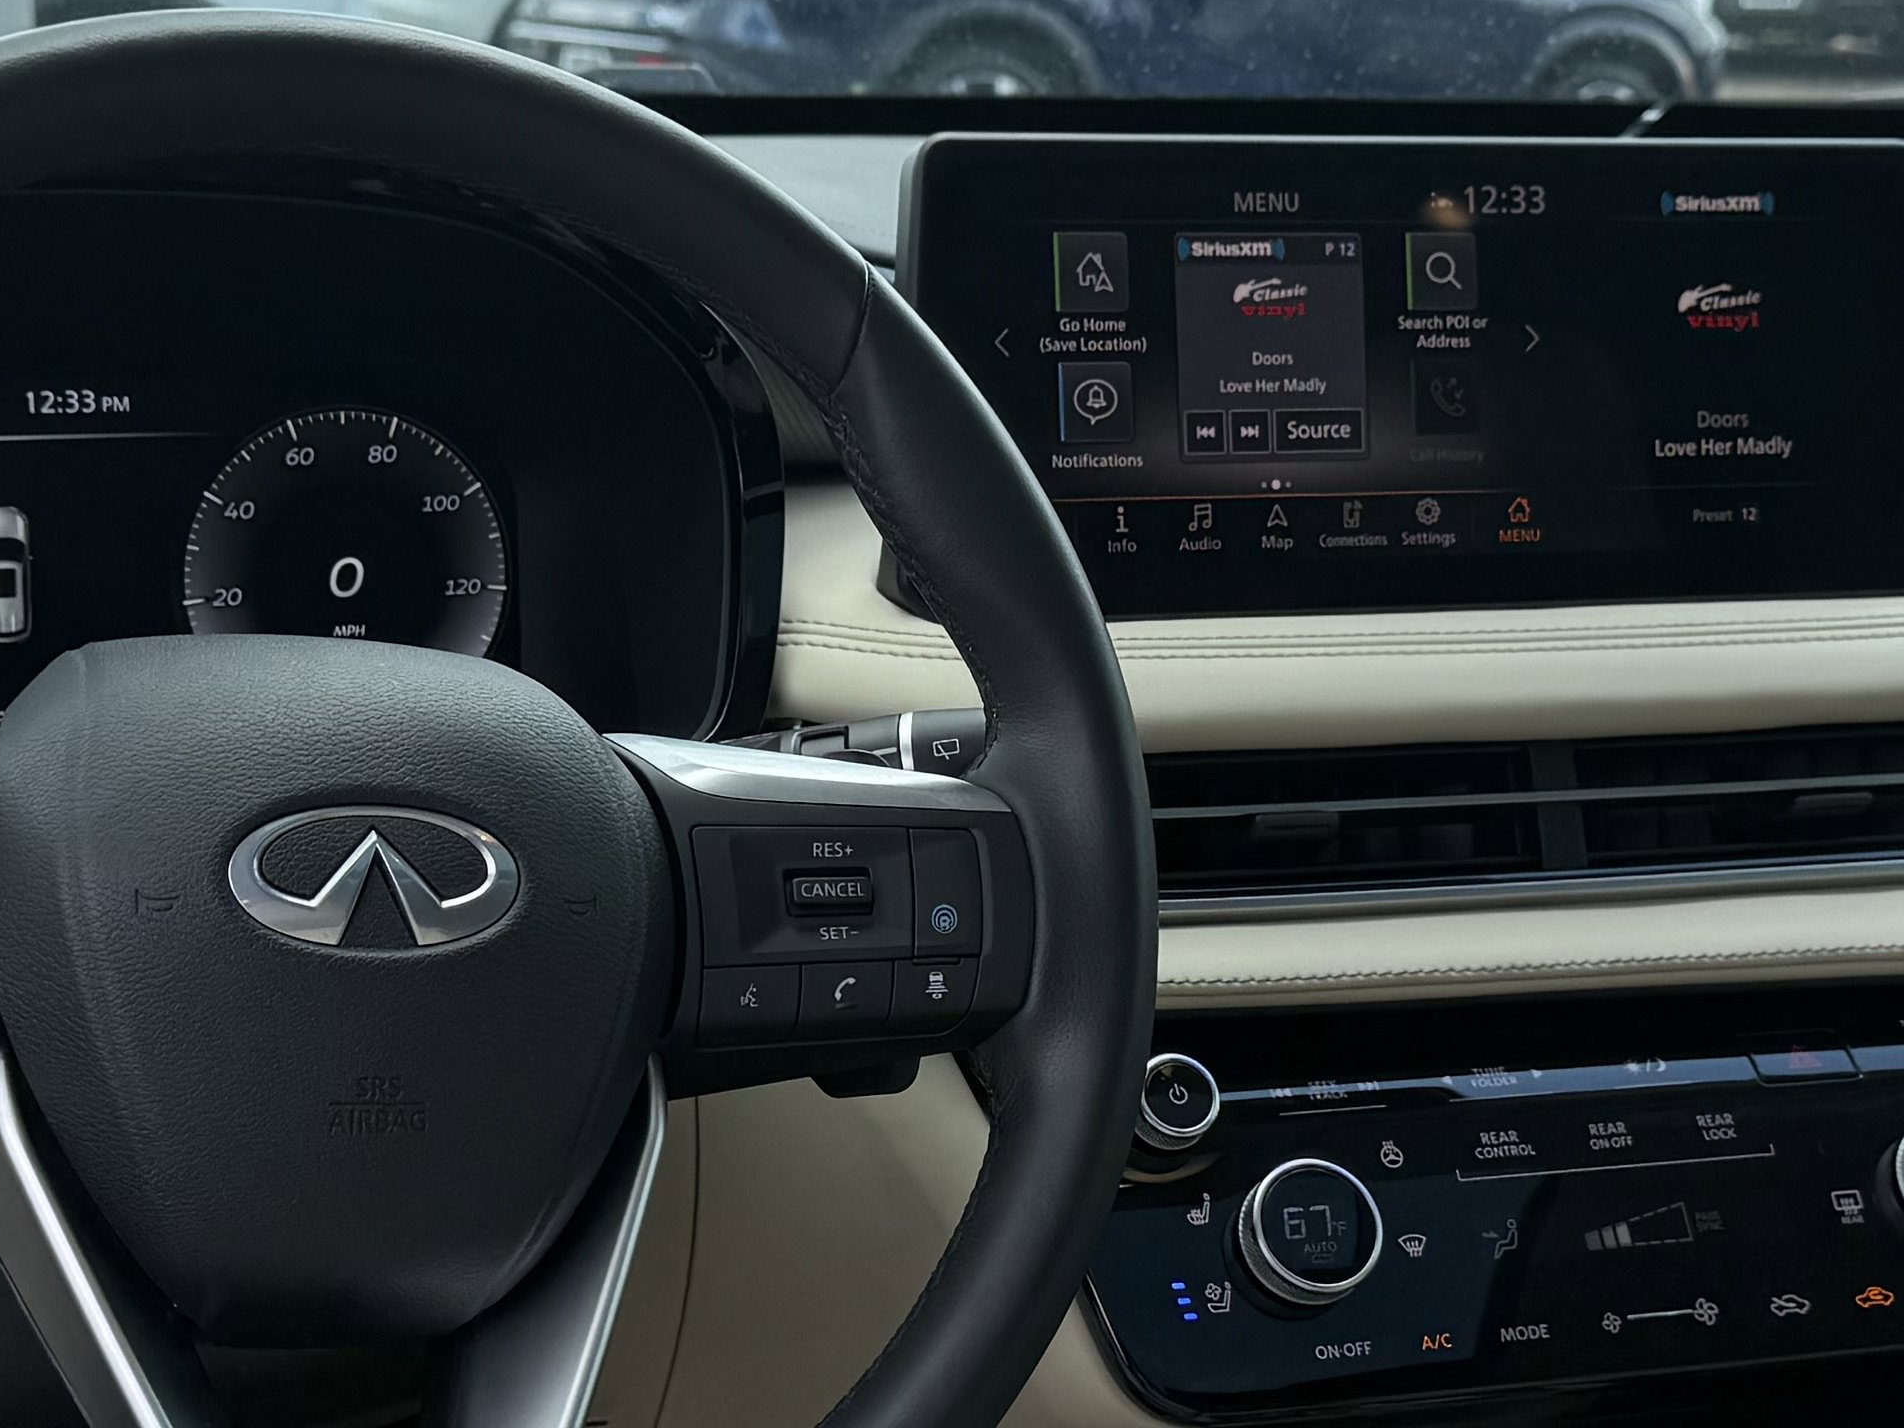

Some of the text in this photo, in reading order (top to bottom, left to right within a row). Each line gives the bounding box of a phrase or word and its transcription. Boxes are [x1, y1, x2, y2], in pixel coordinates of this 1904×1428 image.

[1234, 192, 1299, 213] MENU
[1463, 185, 1546, 214] 12:33
[1326, 243, 1356, 257] P 12
[1700, 290, 1762, 312] Classic
[1059, 318, 1126, 332] Go Home
[1397, 315, 1489, 330] Search POI or
[1039, 337, 1148, 353] (Save Location)
[1416, 334, 1472, 349] Address
[1251, 352, 1295, 366] Doors
[1219, 377, 1327, 395] Love Her Madly
[25, 389, 131, 414] 12:33 PM
[1696, 410, 1750, 428] Doors
[1286, 420, 1352, 440] Source
[367, 444, 397, 464] 80
[1654, 435, 1793, 459] Love Her Madly
[285, 446, 315, 466] 60
[1051, 454, 1144, 469] Notifications
[223, 500, 255, 521] 40
[422, 494, 460, 513] 100
[1742, 507, 1759, 522] 12
[1179, 536, 1222, 551] Audio
[1261, 535, 1294, 551] Map
[1319, 533, 1388, 548] Connections
[1401, 531, 1457, 548] Settings
[1499, 529, 1541, 543] MENU
[1107, 539, 1138, 553] Info
[329, 556, 365, 599] 0
[444, 578, 482, 597] 120
[212, 587, 243, 607] 20
[332, 624, 366, 637] MPH
[812, 842, 854, 858] RES+
[800, 882, 866, 898] CANCEL
[1696, 1113, 1735, 1127] REAR
[1588, 1121, 1629, 1136] REAR
[1702, 1127, 1738, 1141] LOCK
[1479, 1130, 1521, 1146] REAR
[1475, 1143, 1536, 1160] CONTROL
[1304, 1241, 1337, 1253] AUTO
[1500, 1323, 1551, 1343] MODE
[1422, 1332, 1454, 1351] A/C
